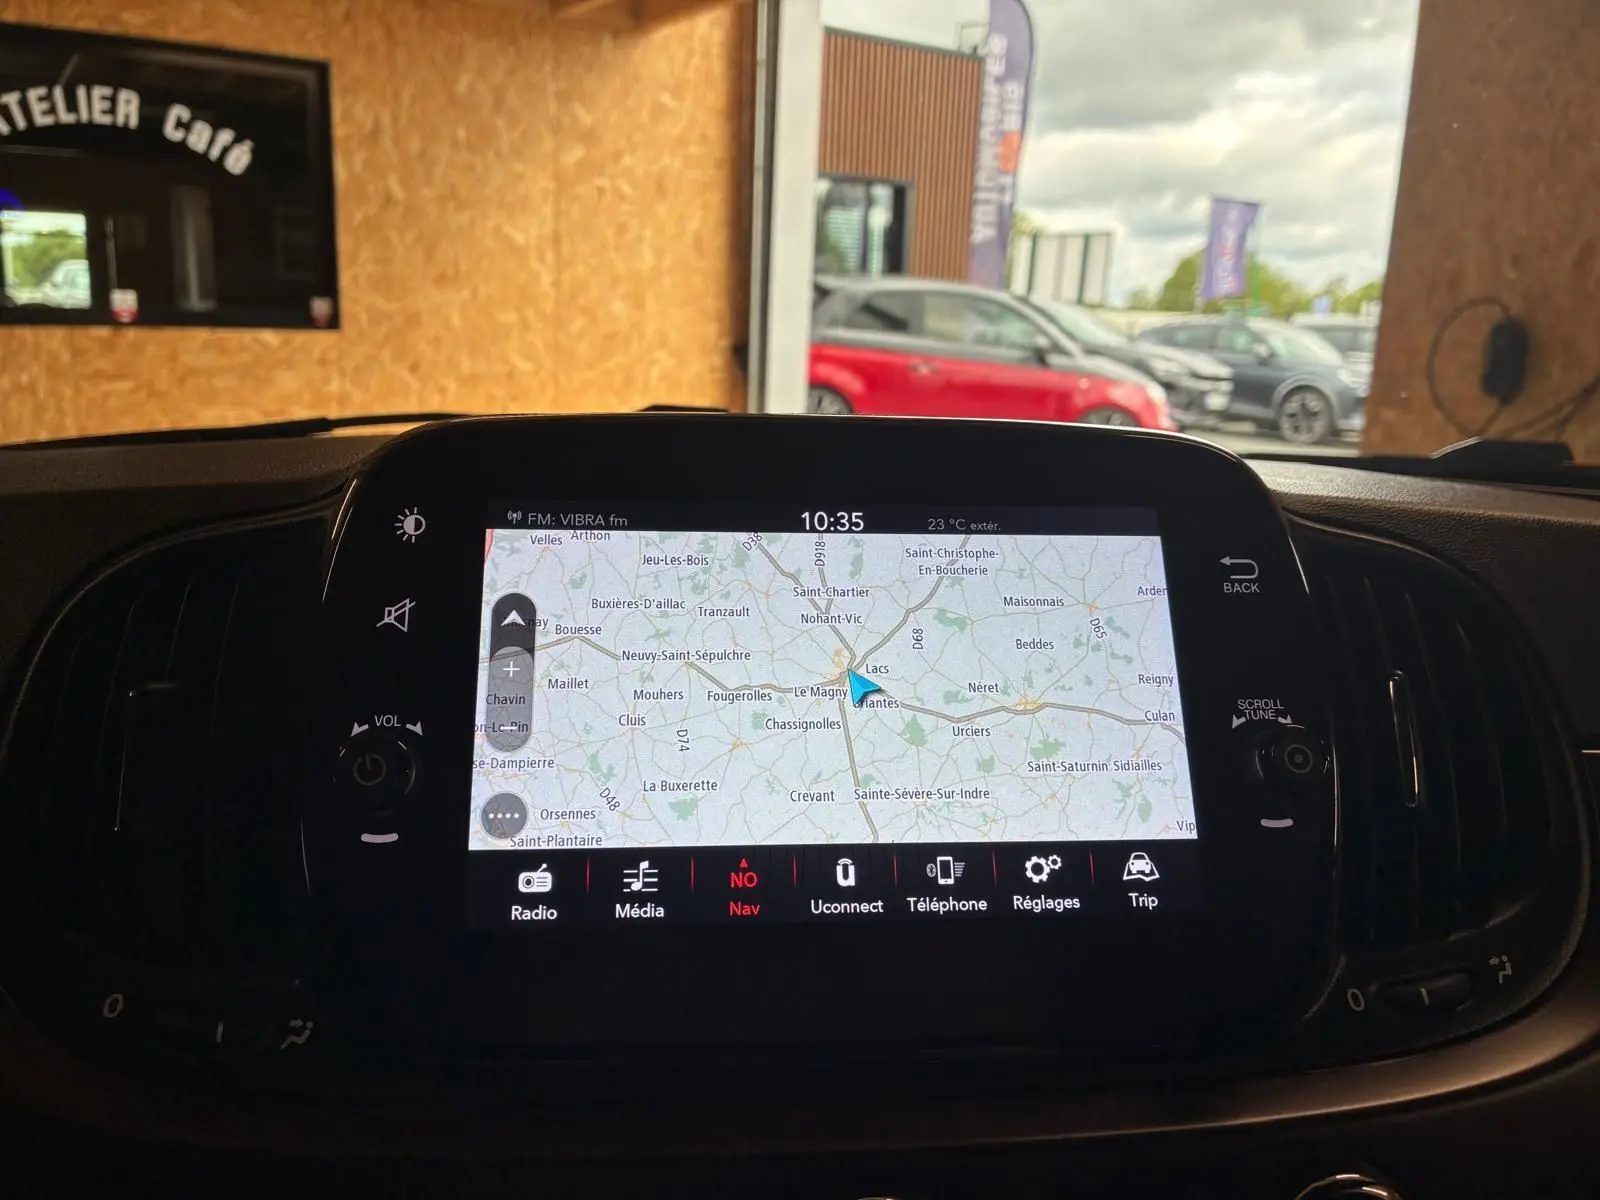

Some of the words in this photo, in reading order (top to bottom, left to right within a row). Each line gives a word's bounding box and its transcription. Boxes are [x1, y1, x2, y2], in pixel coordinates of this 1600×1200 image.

[528, 513, 556, 526] FM:
[560, 514, 606, 526] VIBRA
[609, 514, 628, 527] fm
[801, 511, 864, 531] 10:35
[927, 518, 945, 531] 23
[530, 534, 563, 546] Velles
[571, 530, 610, 541] Arthon
[742, 531, 762, 551] D38
[642, 554, 709, 567] Jeu-Les-Bois
[814, 541, 826, 567] D918
[905, 548, 1000, 562] Saint-Christophe-
[919, 564, 988, 577] En-Boucherie
[793, 586, 870, 598] Saint-Chartier
[1223, 583, 1260, 593] BACK
[591, 598, 686, 611] Buxières-D'aillac
[1003, 596, 1065, 608] Maisonnais
[698, 606, 750, 618] Tranzault
[801, 613, 862, 624] Nohant-Vic
[555, 624, 602, 635] Bouesse
[1089, 617, 1107, 640] D65
[912, 628, 924, 650] D68
[1016, 638, 1055, 650] Beddes
[622, 649, 751, 663] Neuvy-Saint-Sépulchre
[866, 663, 889, 674] Lacs
[548, 677, 589, 689] Maillet
[1138, 674, 1174, 687] Reigny
[633, 689, 684, 700] Mouhers
[794, 686, 805, 698] Le
[810, 686, 849, 700] Magny
[968, 682, 1000, 694] Néret
[486, 693, 526, 705] Chavin
[707, 690, 772, 703] Fougerolles
[1238, 699, 1284, 709] SCROLL
[374, 714, 402, 727] VOL
[618, 715, 646, 727] Cluis
[1145, 710, 1175, 722] Culan
[1244, 710, 1277, 720] TUNE
[765, 718, 841, 732] Chassignolles
[952, 726, 991, 738] Urciers
[676, 729, 690, 752] D74
[1027, 761, 1108, 773] Saint-Saturnin
[1113, 760, 1162, 772] Sidiailles
[643, 780, 657, 792] La
[660, 780, 718, 792] Buxerette
[599, 787, 621, 812] D48
[790, 790, 835, 803] Crevant
[854, 788, 990, 800] Sainte-Sévère-Sur-Indre
[540, 808, 596, 820] Orsennes
[510, 834, 602, 848] Saint-Plantaire
[730, 872, 758, 888] NO
[810, 900, 884, 914] Uconnect
[906, 897, 988, 915] Téléphone
[1013, 895, 1081, 912] Réglages
[1128, 893, 1159, 910] Trip
[511, 906, 558, 921] Radio
[615, 903, 665, 919] Média
[729, 901, 760, 916] Nav
